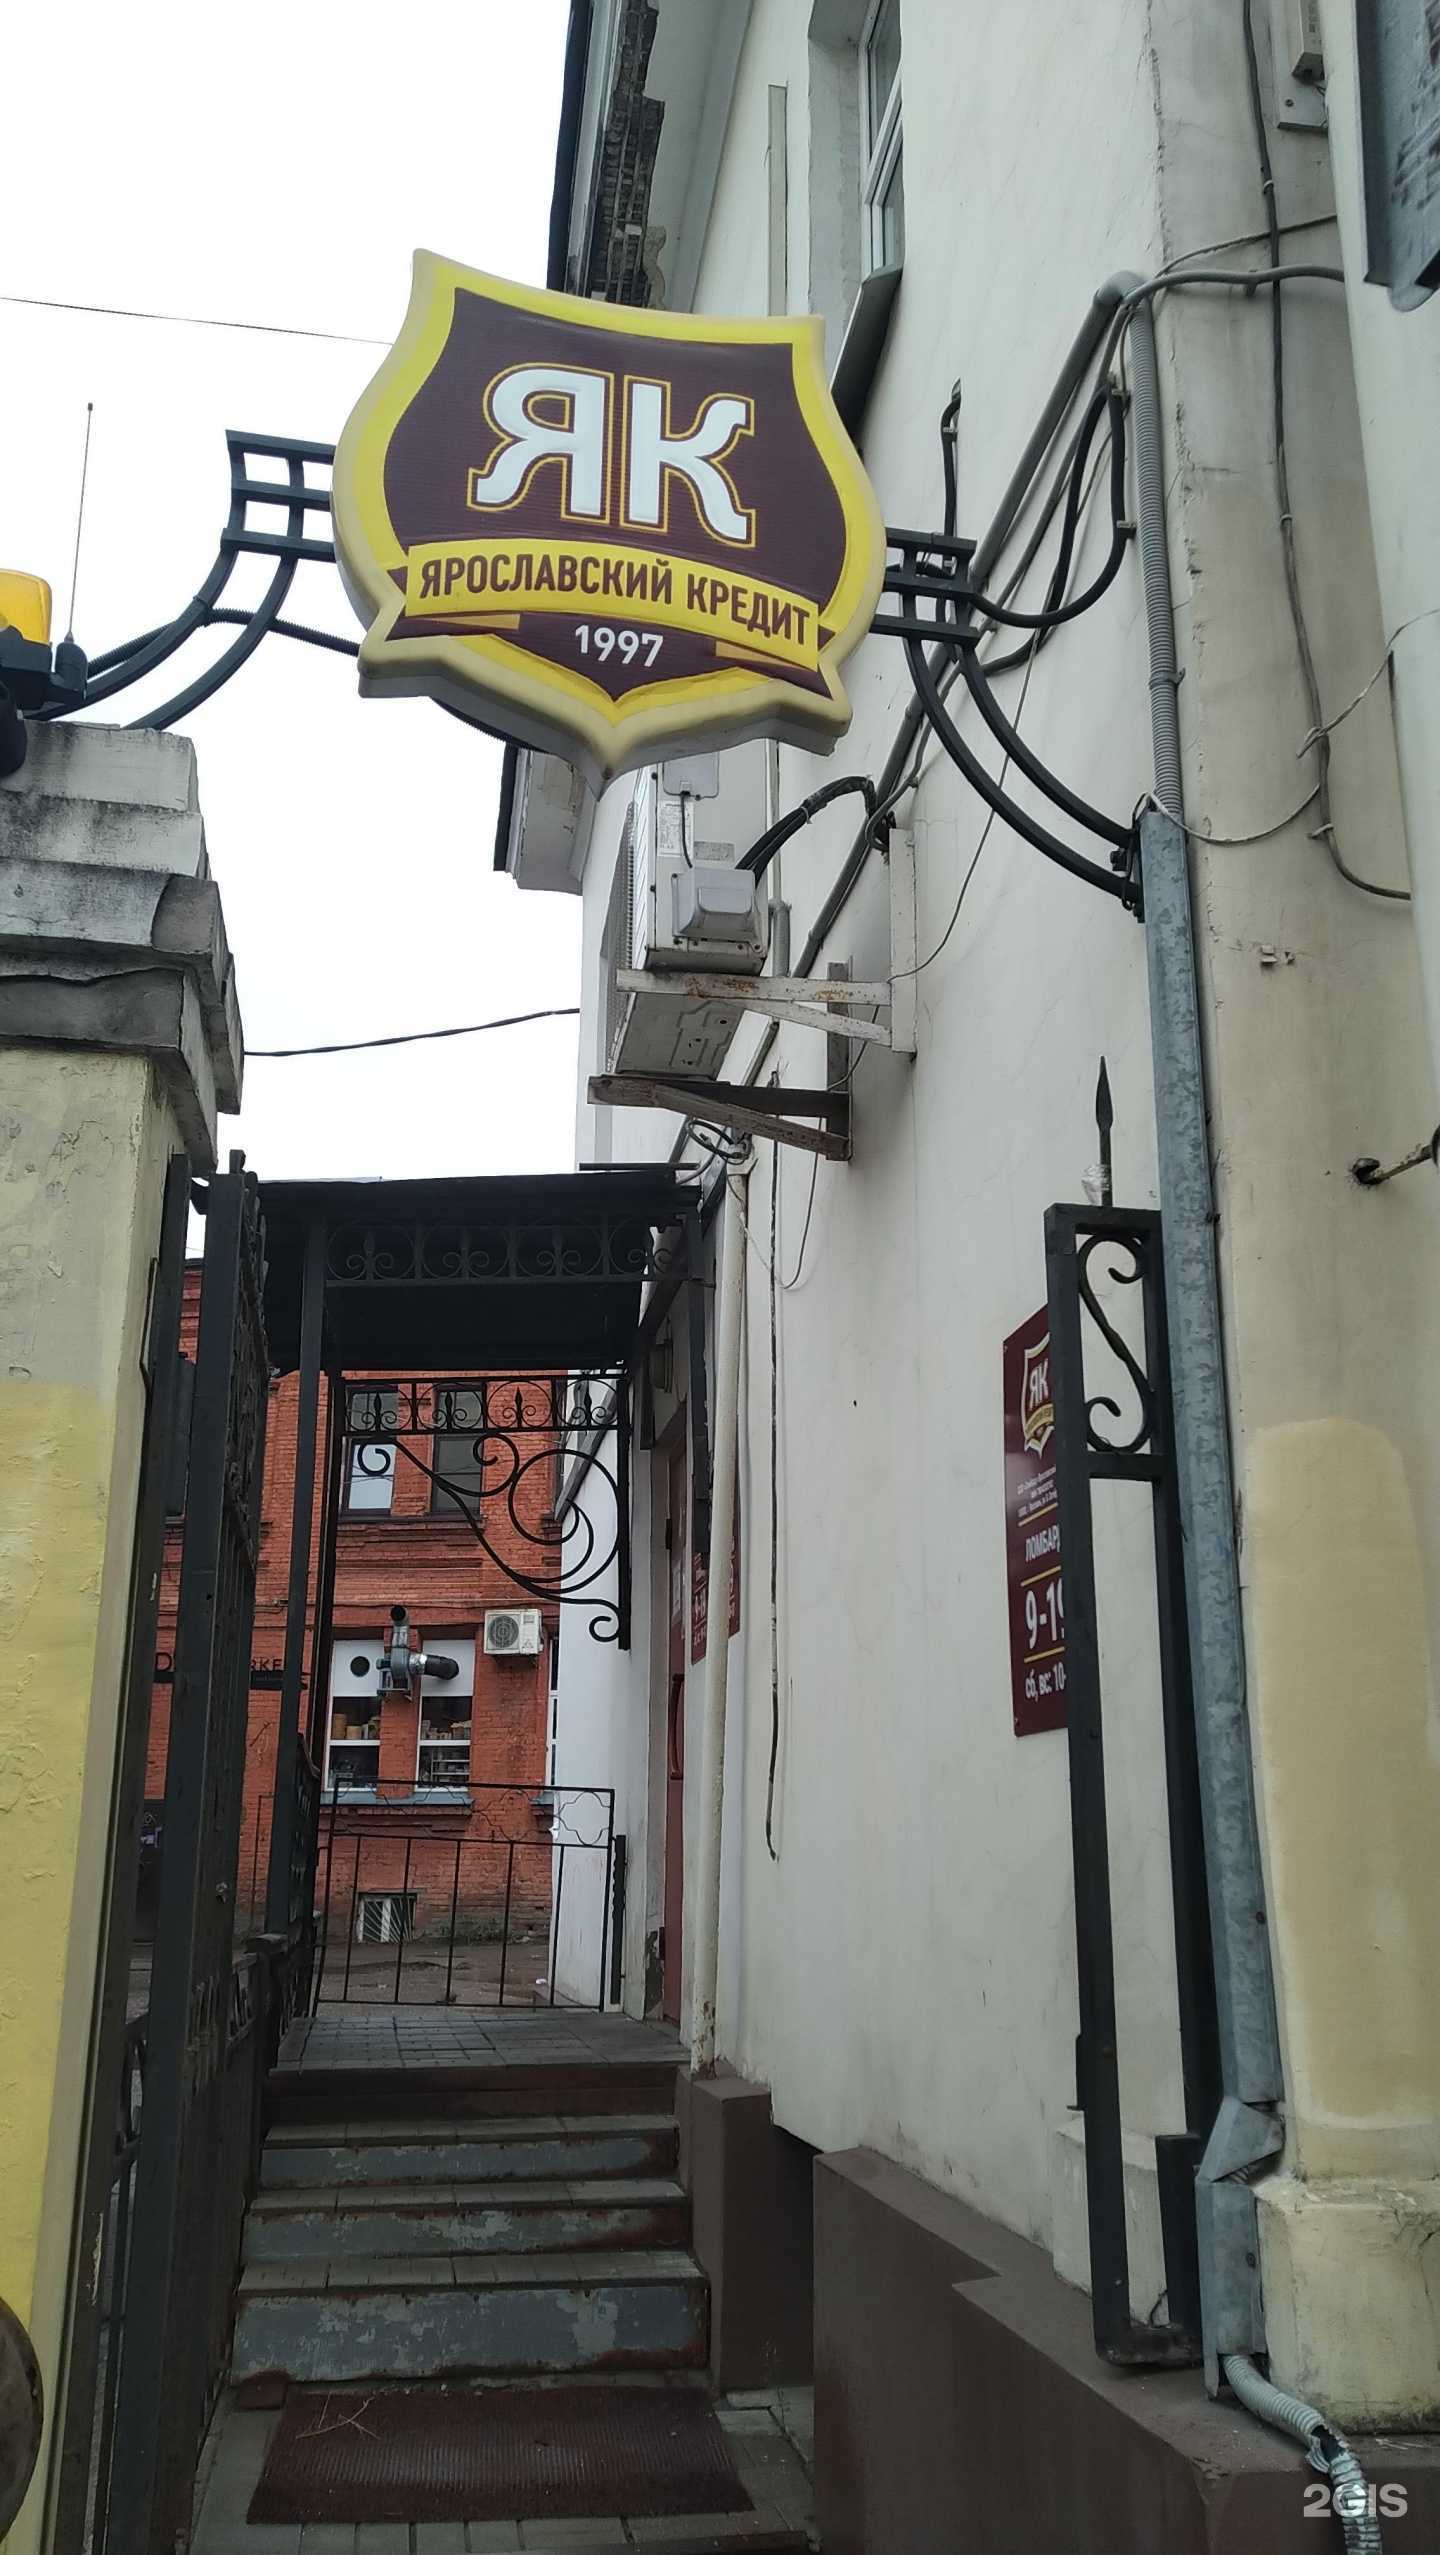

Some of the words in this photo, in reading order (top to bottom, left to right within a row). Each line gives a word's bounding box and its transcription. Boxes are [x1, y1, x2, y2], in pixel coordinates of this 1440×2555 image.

[468, 363, 756, 547] ЯК
[419, 553, 673, 605] ЯРОСЛАВСКИЙ
[686, 573, 811, 646] КРЕДИТ
[574, 624, 664, 668] 1997
[1025, 1524, 1061, 1562] ЛОМБАР
